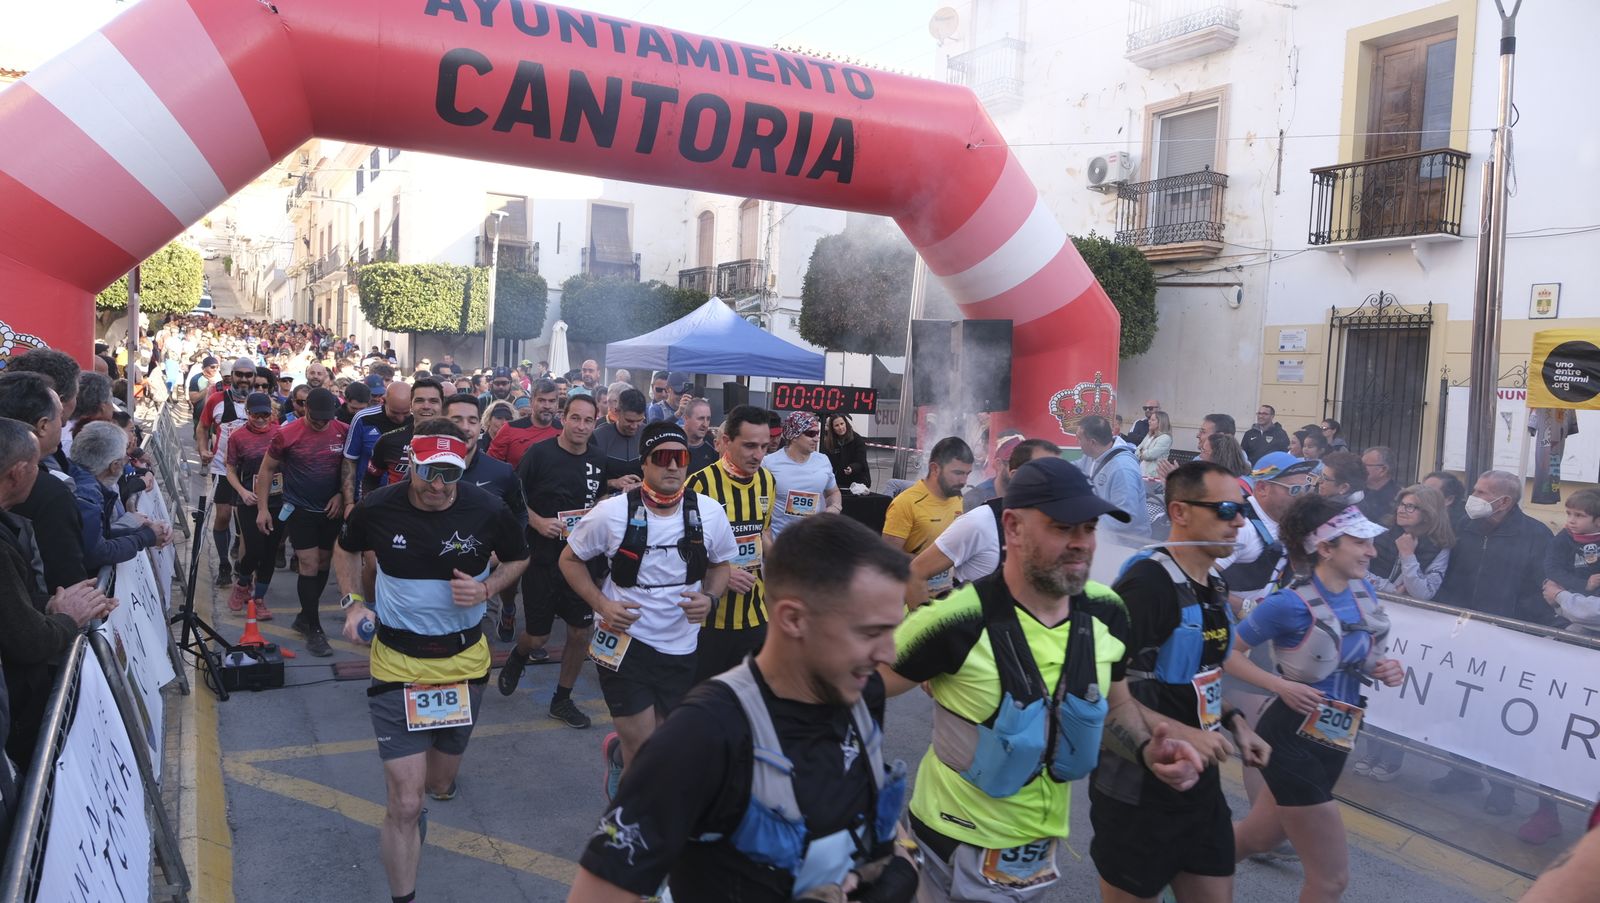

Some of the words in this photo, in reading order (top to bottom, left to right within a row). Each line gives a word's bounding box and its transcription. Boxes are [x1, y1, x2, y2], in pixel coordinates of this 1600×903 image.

[424, 0, 875, 100] AYUNTAMIENTO
[435, 47, 855, 184] CANTORIA
[1552, 382, 1570, 391] .org
[1553, 375, 1589, 383] cienmil
[775, 385, 874, 411] 00:00:14
[792, 496, 814, 507] 296
[417, 690, 458, 708] 318
[1319, 708, 1353, 731] 200
